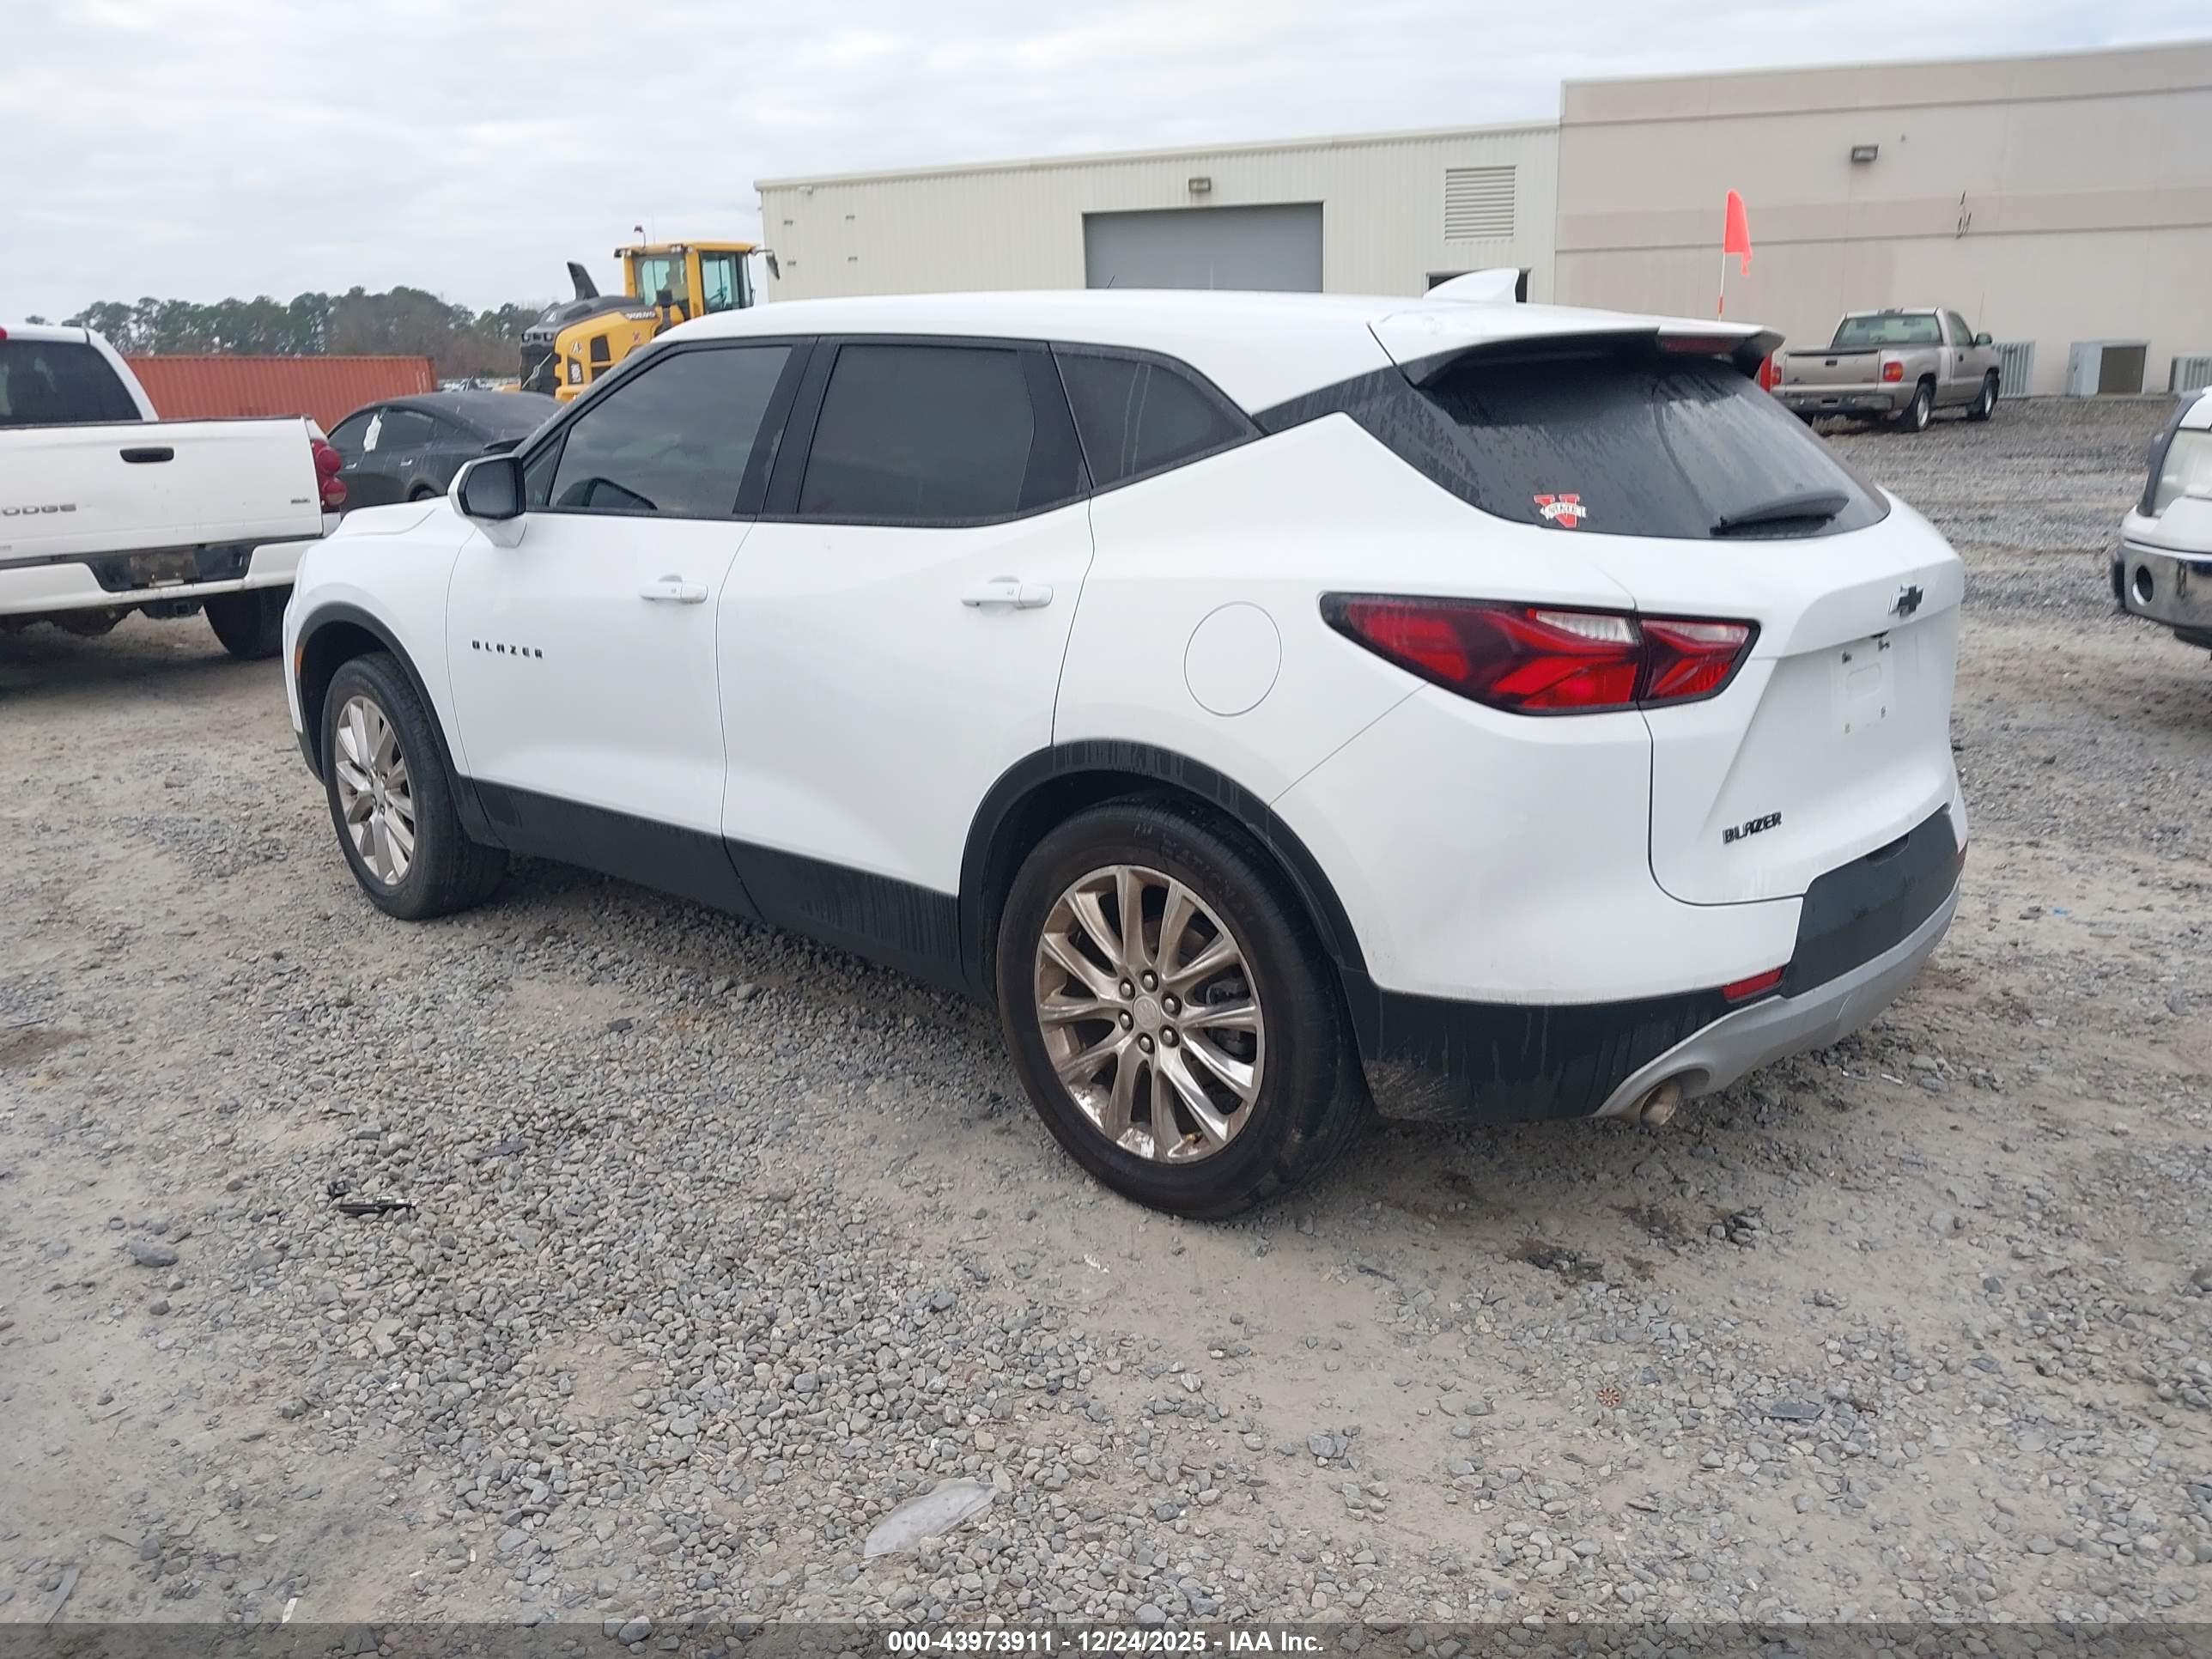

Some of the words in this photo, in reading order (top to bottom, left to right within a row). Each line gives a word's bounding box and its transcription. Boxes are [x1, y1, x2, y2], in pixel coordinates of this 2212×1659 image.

[0, 503, 76, 516] ODGE
[471, 640, 544, 659] BLAZER
[1723, 811, 1782, 845] BLAZER
